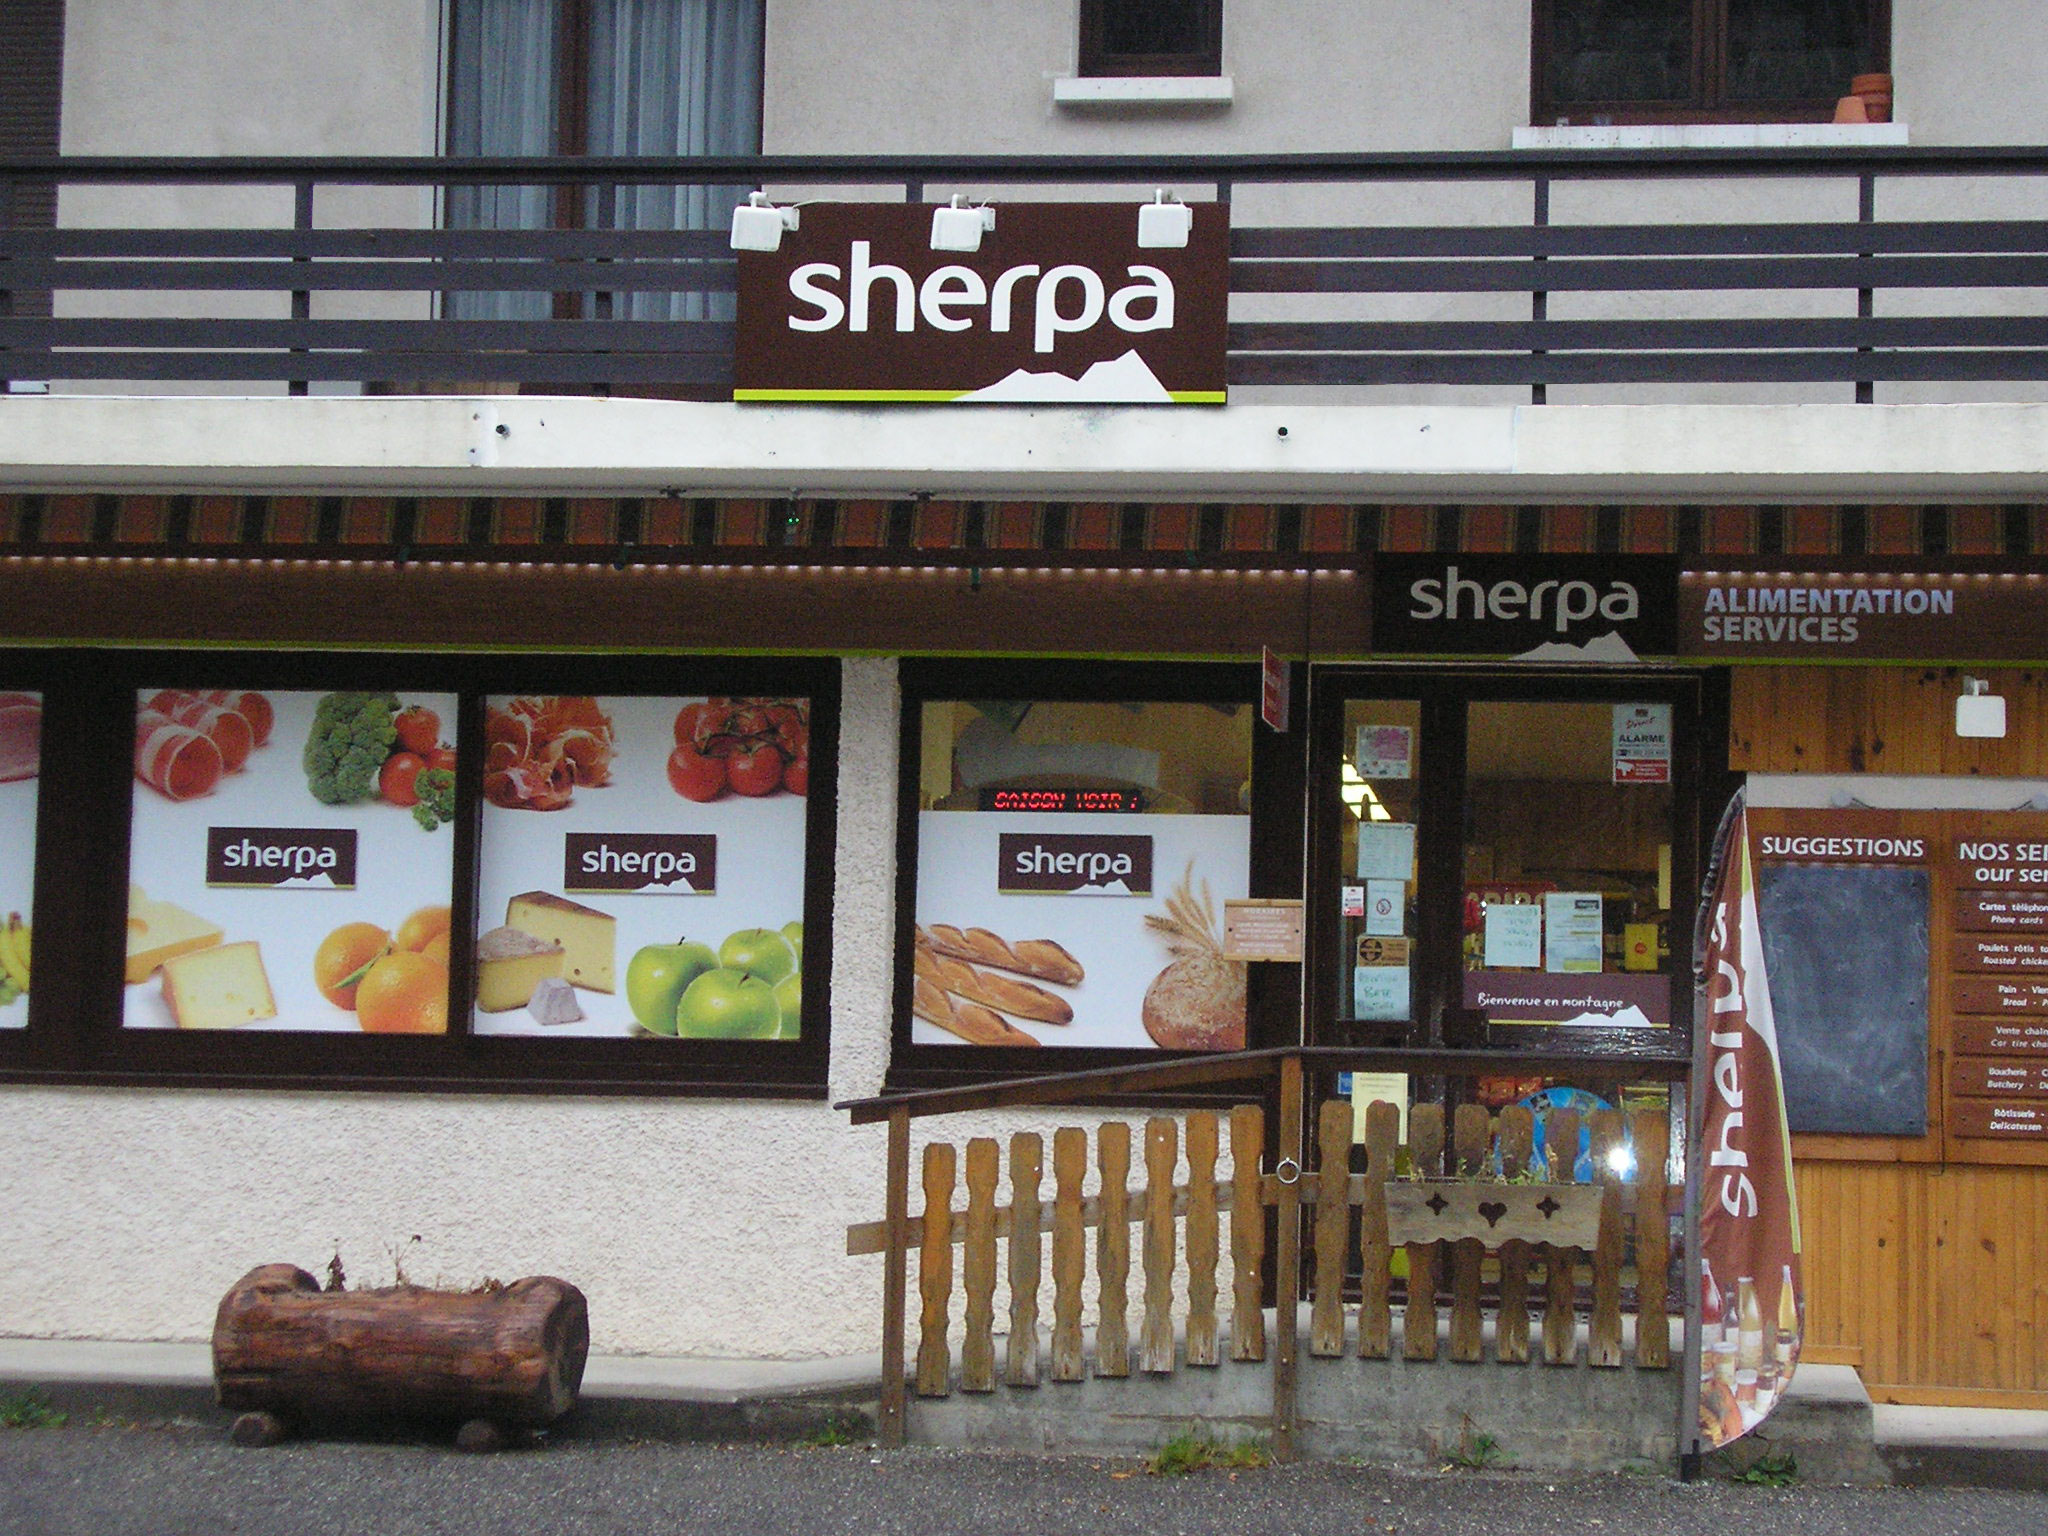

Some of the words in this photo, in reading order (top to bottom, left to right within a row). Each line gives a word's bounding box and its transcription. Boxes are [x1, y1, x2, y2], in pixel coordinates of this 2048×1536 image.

[788, 240, 1175, 353] sherpa
[1410, 565, 1640, 632] sherpa
[1704, 587, 1954, 616] ALIMENTATION
[1703, 616, 1859, 643] SERVICES
[1619, 734, 1665, 743] ALARME
[1761, 836, 1924, 858] SUGGESTIONS
[1959, 842, 2009, 861] NOS
[223, 837, 338, 875] sherpa
[581, 843, 697, 881] sherpa
[1016, 845, 1132, 881] sherpa
[1975, 867, 2014, 882] our
[1979, 902, 2006, 911] Cartes
[1991, 916, 2016, 924] Phone
[2020, 916, 2044, 925] cards
[1978, 944, 2009, 952] Poulets
[1983, 956, 2017, 965] Roasted
[1998, 985, 2017, 994] Pain
[1477, 992, 1541, 1006] Bienvenue
[1544, 998, 1559, 1006] en
[1562, 996, 1624, 1011] montagne
[2002, 998, 2028, 1007] Bread
[1995, 1026, 2021, 1035] Vente
[1990, 1039, 2007, 1048] Car
[1988, 1067, 2027, 1077] Boucherie
[1987, 1080, 2024, 1090] Butchery
[1989, 1121, 2042, 1131] Delicatessen
